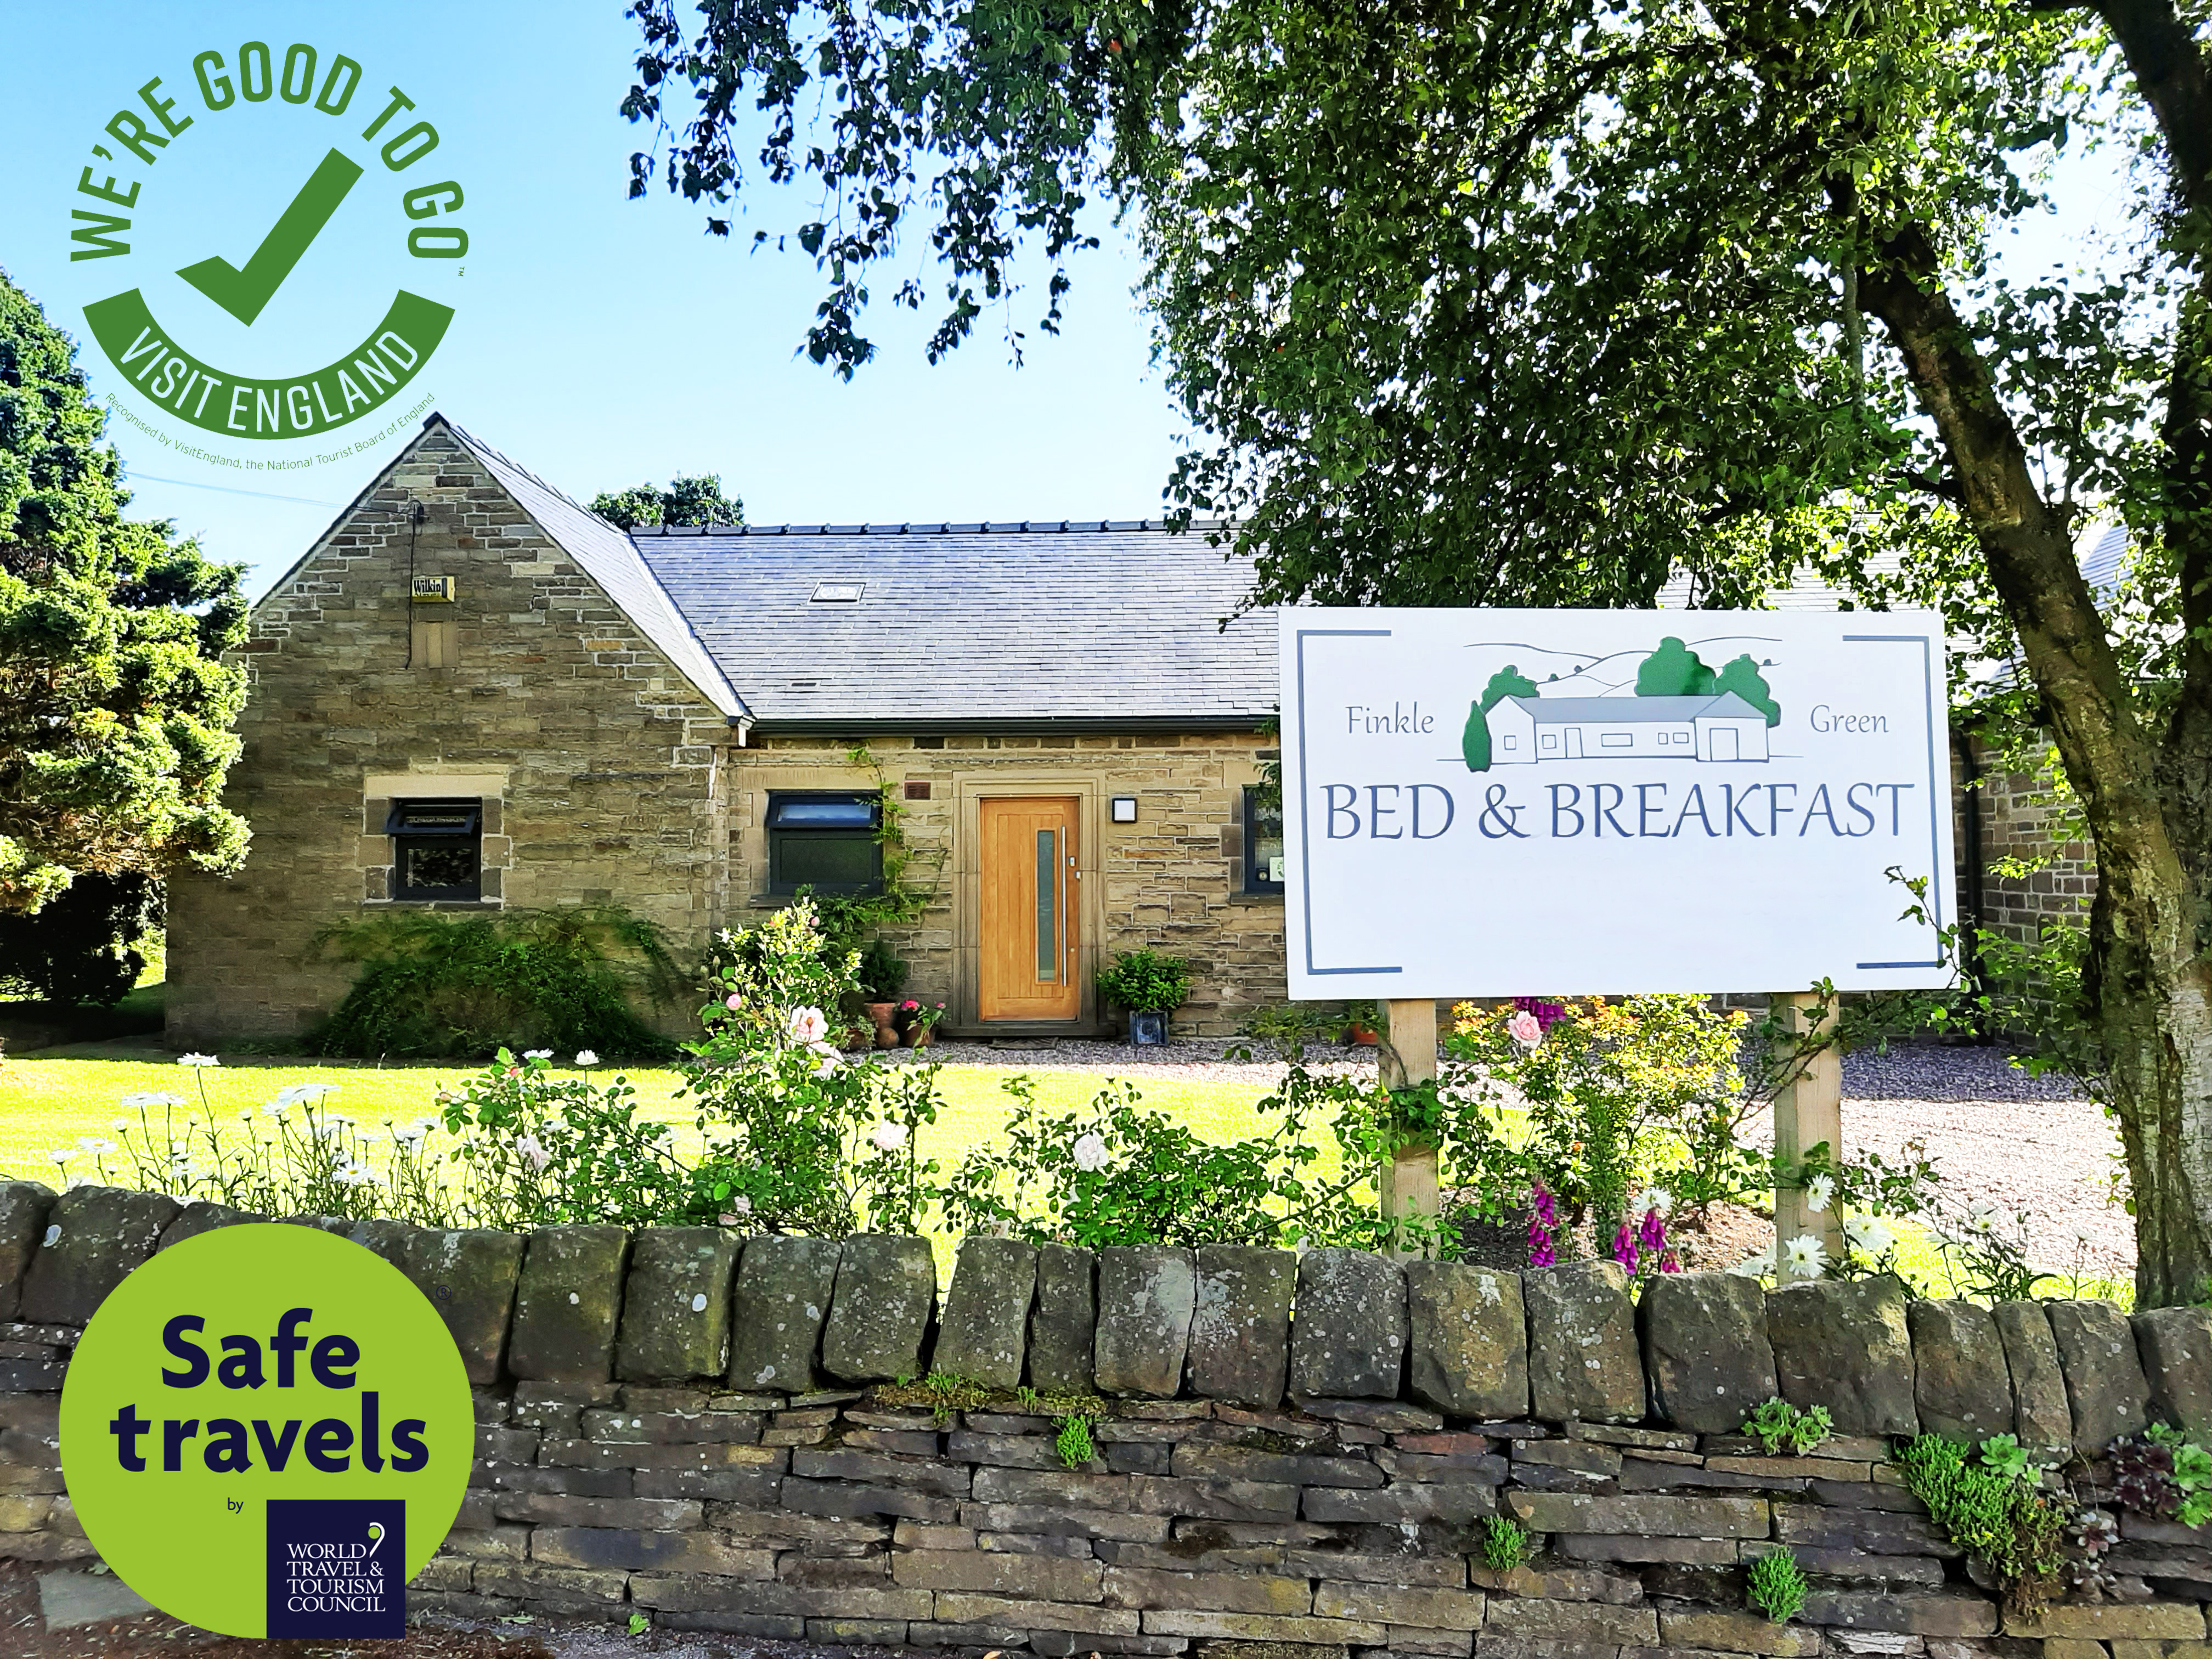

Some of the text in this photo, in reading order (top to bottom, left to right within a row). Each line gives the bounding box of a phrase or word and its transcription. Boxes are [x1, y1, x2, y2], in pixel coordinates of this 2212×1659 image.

[1345, 701, 1889, 734] Finkle Green
[1319, 782, 1915, 839] BED & BREAKFAST
